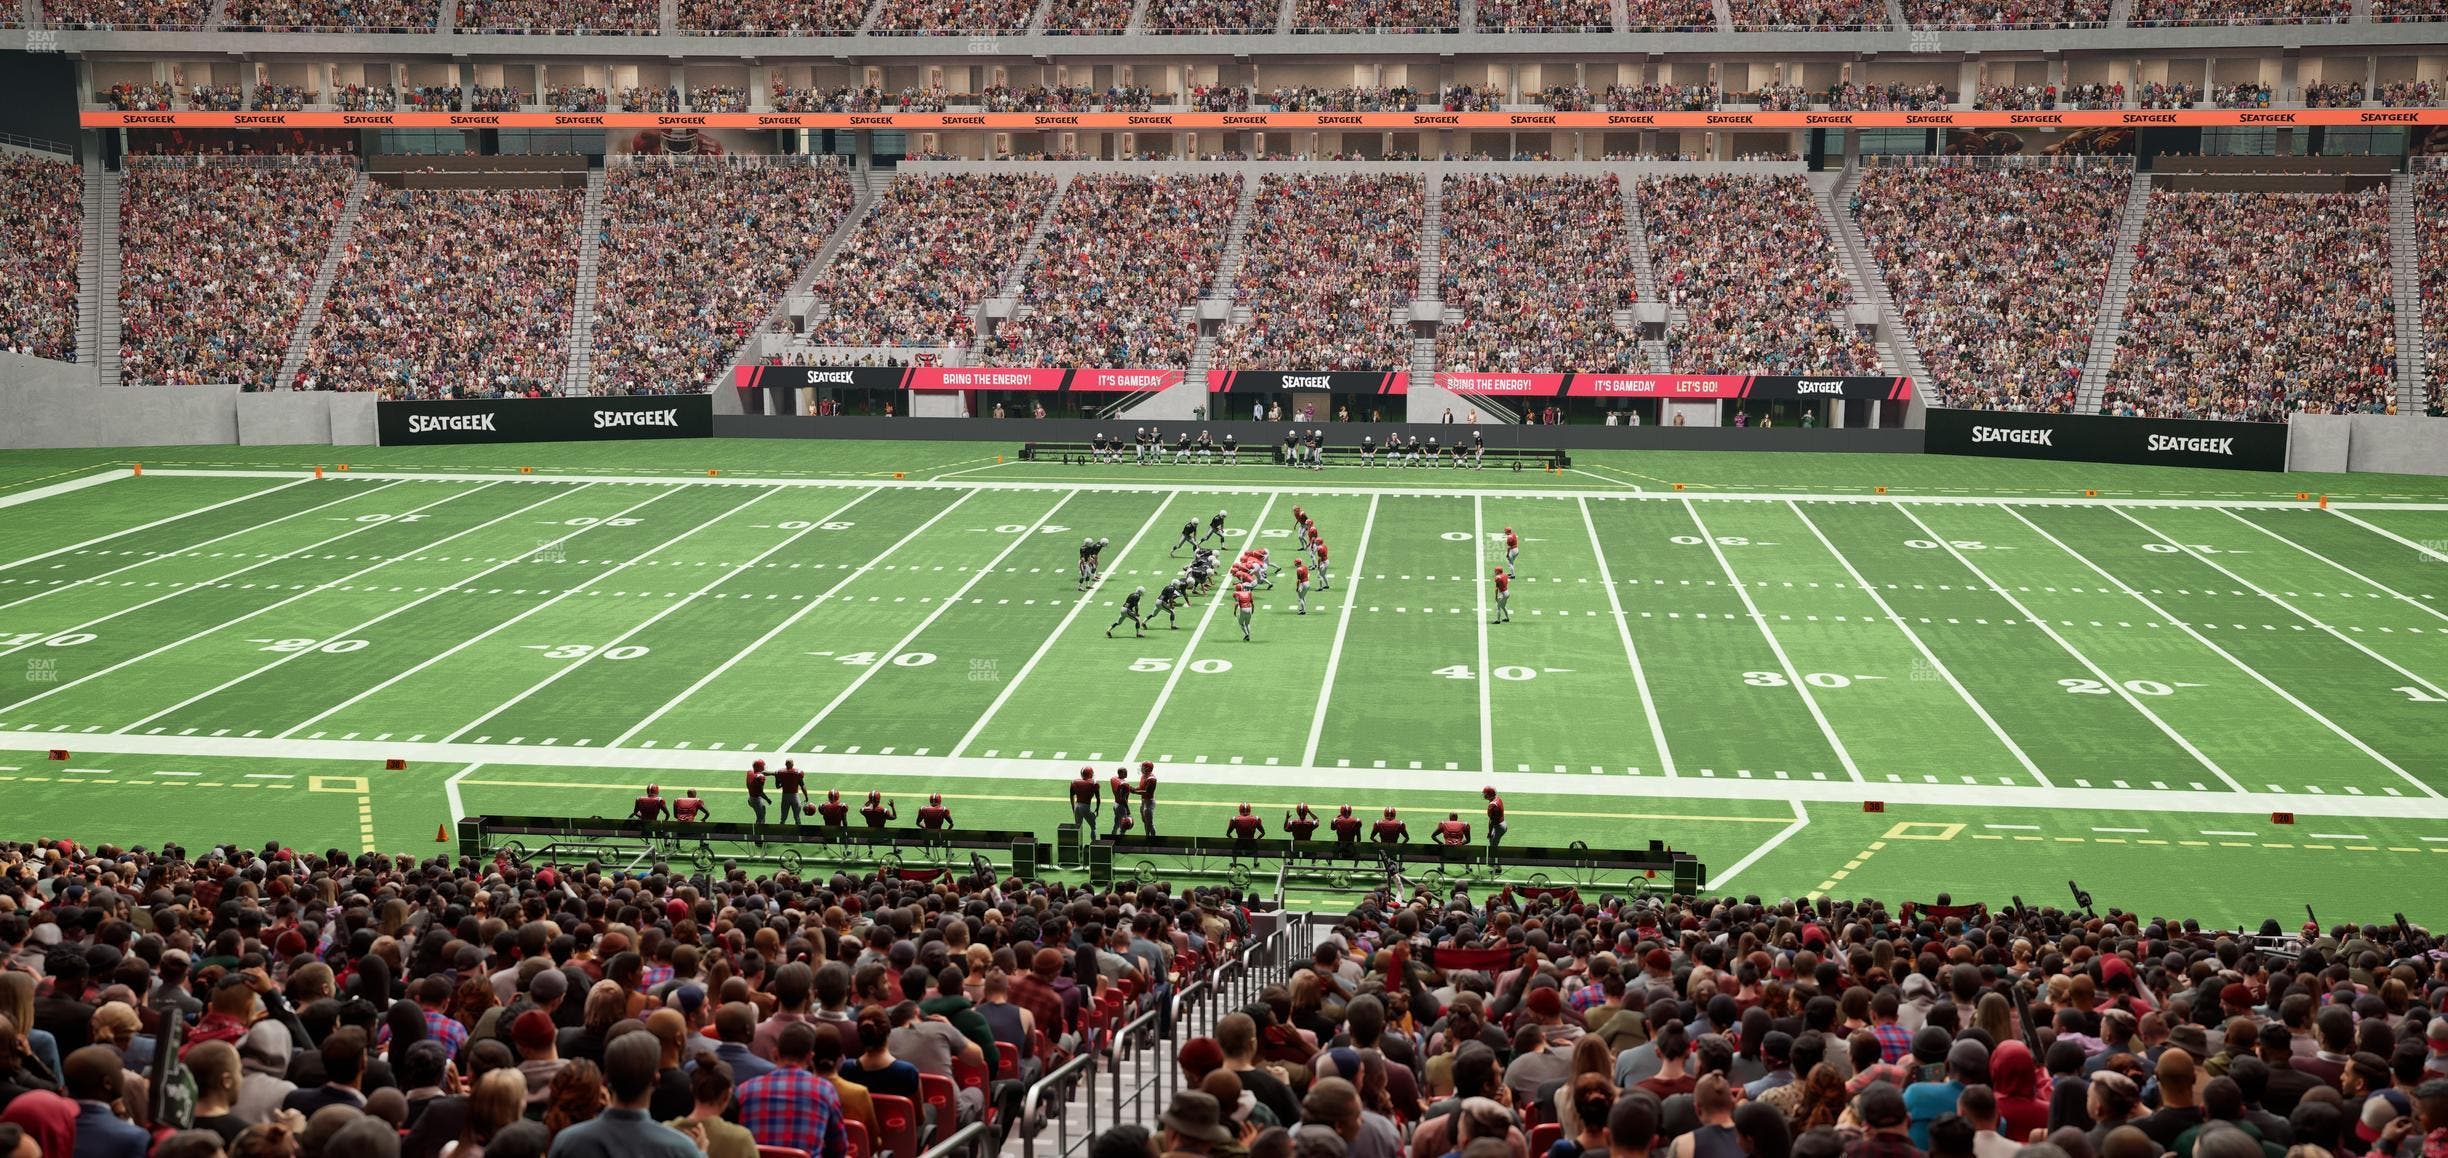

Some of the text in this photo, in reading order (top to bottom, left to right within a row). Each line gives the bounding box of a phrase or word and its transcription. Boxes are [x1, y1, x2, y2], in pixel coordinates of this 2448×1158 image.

[122, 114, 176, 124] SEATGEEK
[234, 115, 286, 124] SEATGEEK
[343, 115, 393, 124] SEATGEEK
[450, 115, 500, 125] SEATGEEK
[555, 116, 604, 125] SEATGEEK
[658, 116, 706, 125] SEATGEEK
[758, 116, 801, 125] SEATGEEK
[850, 116, 893, 125] SEATGEEK
[942, 116, 985, 125] SEATGEEK
[1034, 116, 1079, 125] SEATGEEK
[1128, 115, 1173, 125] SEATGEEK
[1222, 115, 1266, 125] SEATGEEK
[1317, 115, 1363, 125] SEATGEEK
[1414, 115, 1459, 125] SEATGEEK
[1510, 115, 1556, 125] SEATGEEK
[1608, 115, 1654, 125] SEATGEEK
[1706, 115, 1753, 124] SEATGEEK
[1806, 115, 1853, 124] SEATGEEK
[1906, 115, 1953, 124] SEATGEEK
[2010, 114, 2063, 124] SEATGEEK
[2122, 113, 2177, 123] SEATGEEK
[2239, 113, 2296, 123] SEATGEEK
[2360, 112, 2419, 122] SEATGEEK
[807, 370, 855, 385] SEATGEEK
[943, 373, 1032, 385] BRING THE ENERGY!
[1098, 375, 1162, 387] IT'S GAMEDAY
[1281, 374, 1331, 390] SEATGEEK
[1447, 378, 1532, 391] BRING THE ENERGY!
[1595, 380, 1656, 392] IT'S GAMEDAY
[1676, 380, 1718, 393] LET'S GO!
[1797, 380, 1844, 395] SEATGEEK
[408, 412, 497, 433] SEATGEEK
[593, 408, 679, 429] SEATGEEK
[1971, 425, 2053, 446] SEATGEEK
[2147, 433, 2234, 455] SEATGEEK
[257, 638, 370, 653] 20
[542, 644, 650, 660] 30
[834, 651, 937, 667] 40
[1127, 657, 1233, 673] 50
[1431, 664, 1537, 680] 40
[1742, 671, 1850, 688] 30
[2057, 678, 2174, 696] 20
